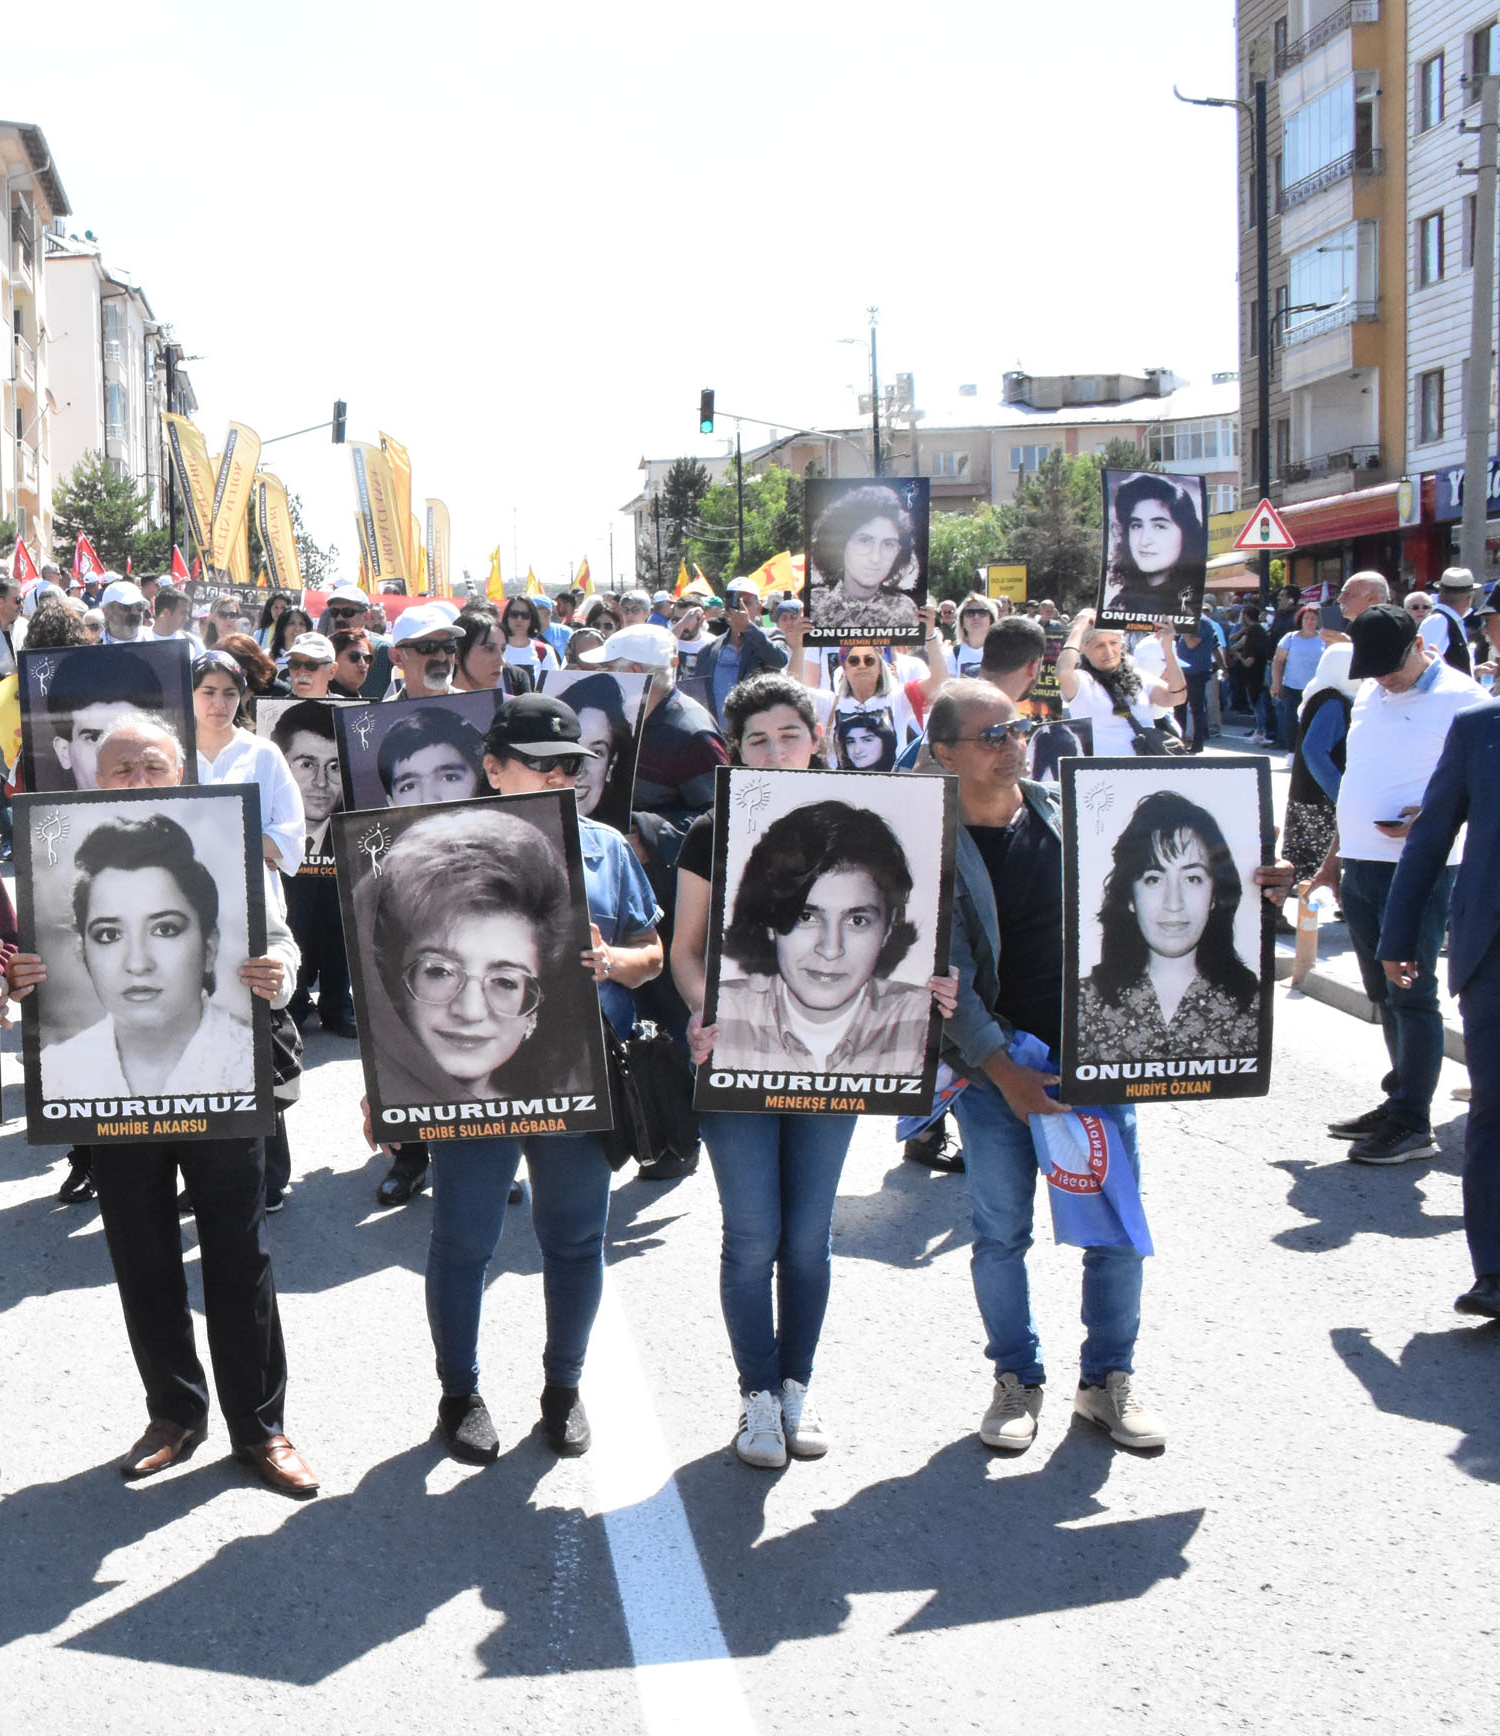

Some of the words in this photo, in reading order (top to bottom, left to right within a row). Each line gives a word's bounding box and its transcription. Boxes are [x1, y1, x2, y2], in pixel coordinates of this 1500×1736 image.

[809, 627, 920, 637] ONURUMUZ
[1075, 1057, 1258, 1081] ONURUMUZ
[708, 1072, 923, 1095] ONURUMUZ
[1126, 1080, 1167, 1097] HURİYE
[1170, 1079, 1212, 1094] ÖZKAN
[42, 1095, 257, 1120] ONURUMUZ
[381, 1095, 597, 1124] ONURUMUZ
[764, 1095, 826, 1113] MENEKŞE
[830, 1097, 866, 1111] KAYA
[97, 1118, 149, 1137] MUHİBE
[153, 1119, 207, 1135] AKARSU
[419, 1123, 456, 1140] EDİBE
[459, 1119, 506, 1137] SULARİ
[510, 1116, 567, 1134] AĞBABA
